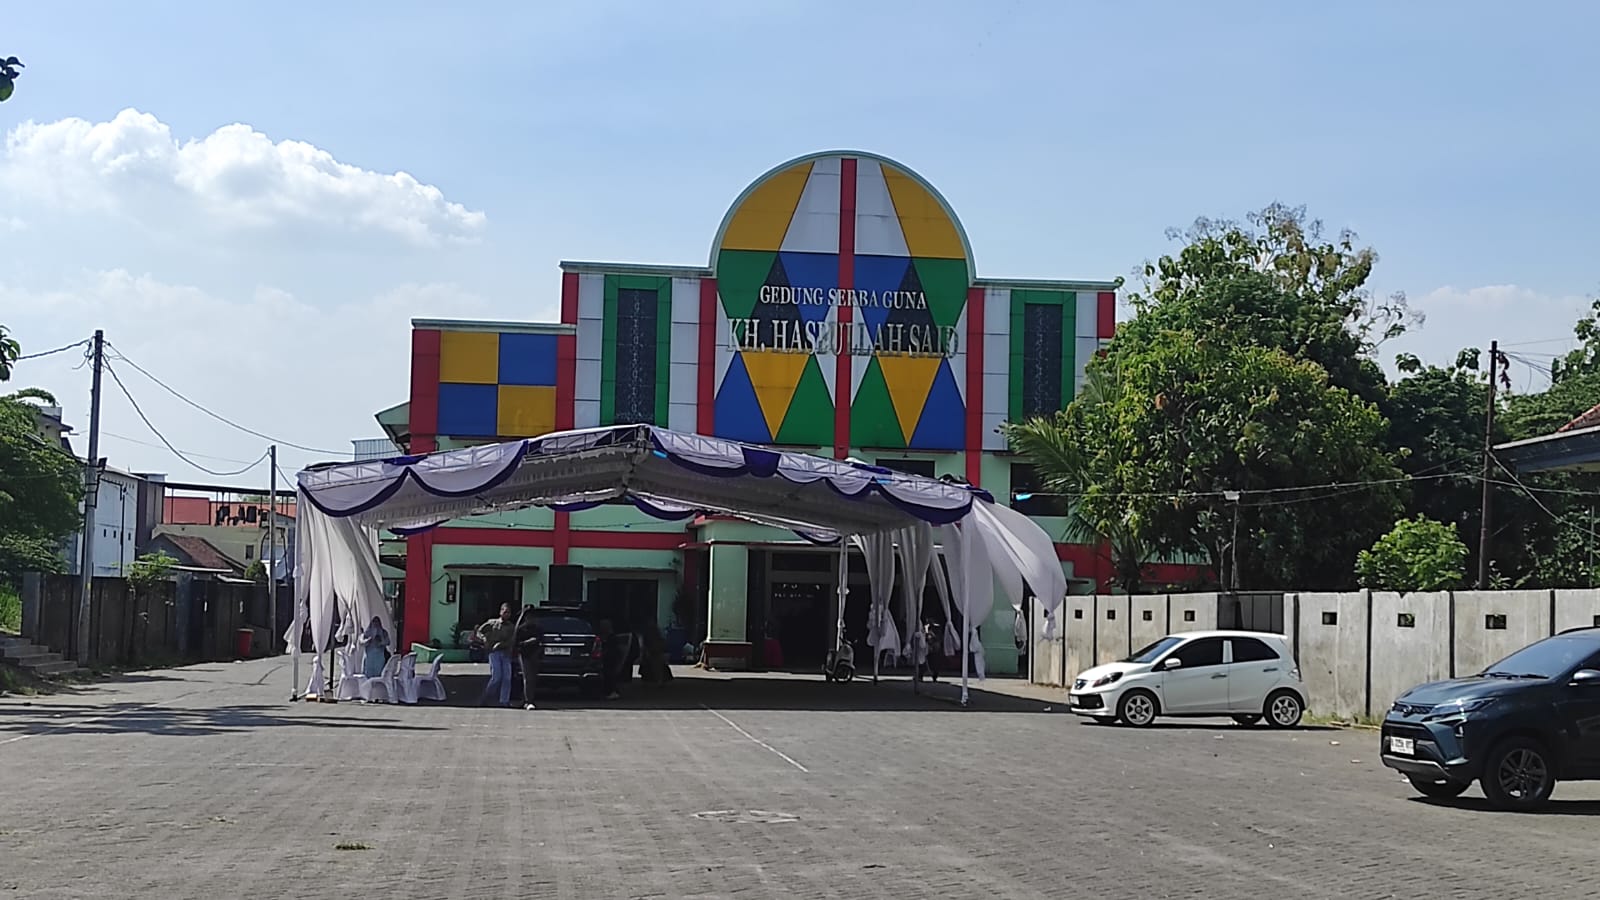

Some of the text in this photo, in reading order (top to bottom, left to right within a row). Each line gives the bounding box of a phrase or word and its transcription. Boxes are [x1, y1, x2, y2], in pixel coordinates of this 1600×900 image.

[760, 285, 927, 309] GEDUNG SERBA GUNA
[727, 318, 959, 358] KH. HASBULLAH SAID
